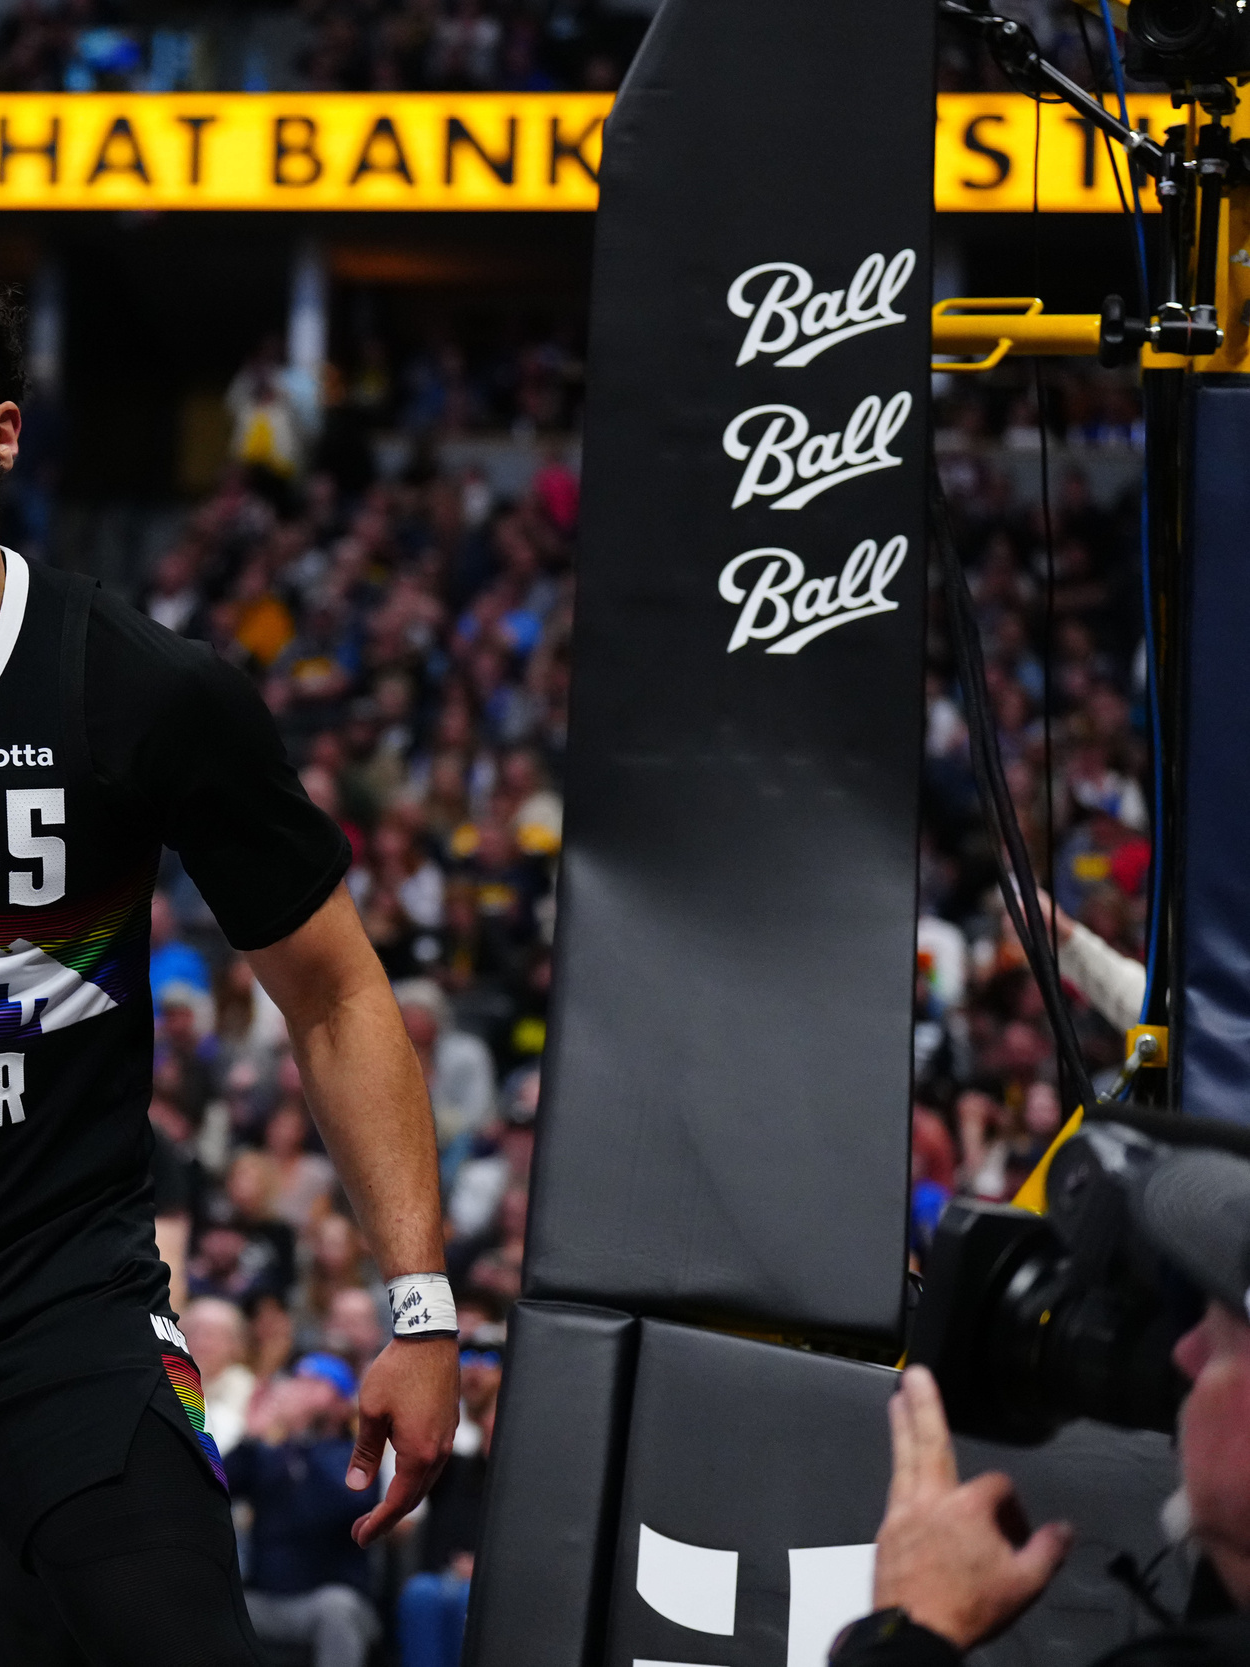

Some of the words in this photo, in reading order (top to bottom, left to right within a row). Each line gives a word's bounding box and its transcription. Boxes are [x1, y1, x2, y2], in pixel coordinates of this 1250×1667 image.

[726, 248, 916, 367] Ball
[722, 390, 913, 510] Ball
[717, 534, 909, 654] Ball
